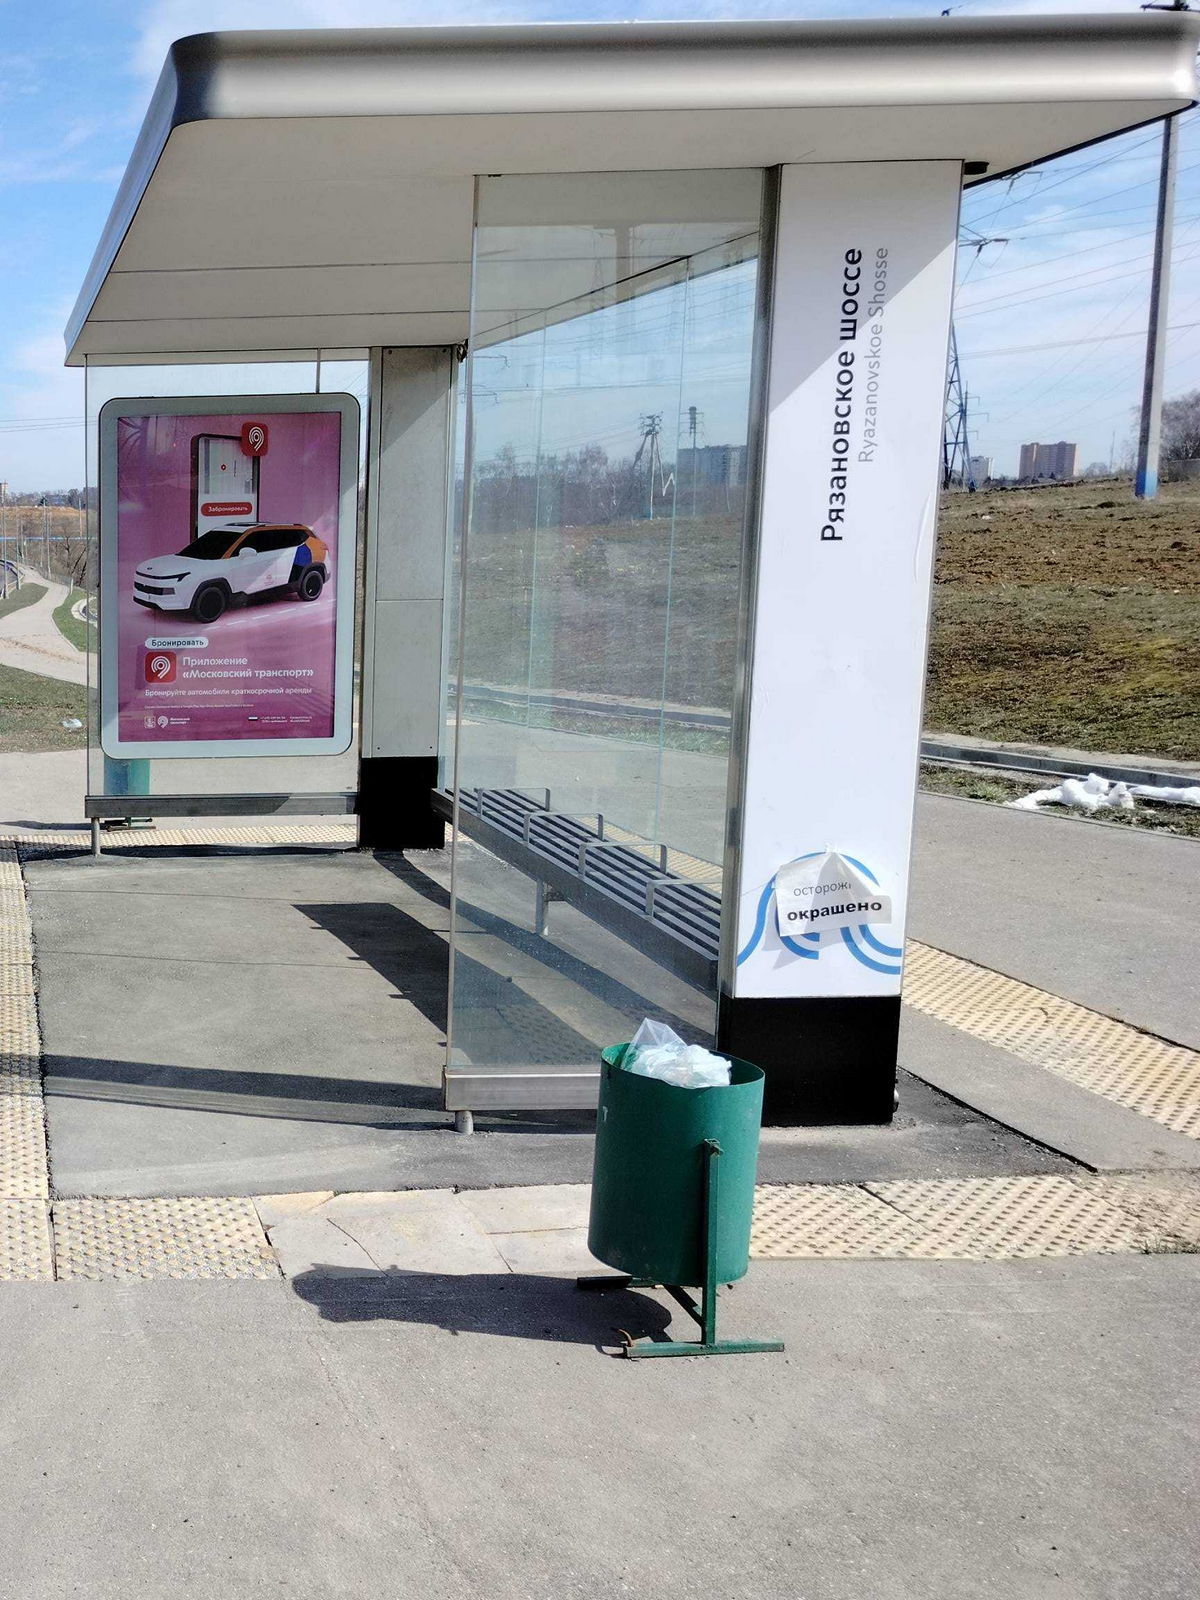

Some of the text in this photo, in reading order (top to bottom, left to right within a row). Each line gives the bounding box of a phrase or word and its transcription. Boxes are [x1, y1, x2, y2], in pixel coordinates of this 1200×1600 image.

[858, 247, 889, 463] Ryazanovskoe Shosse
[820, 247, 863, 541] Рязановское шоссе
[151, 639, 204, 647] Бронировать
[182, 656, 248, 667] Приложение
[182, 668, 314, 679] «Московский транспорт»
[145, 689, 187, 698] Бронируйте
[188, 688, 230, 696] автомобили
[231, 687, 284, 696] краткосрочной
[793, 881, 852, 897] осторож
[787, 900, 882, 922] окрашено
